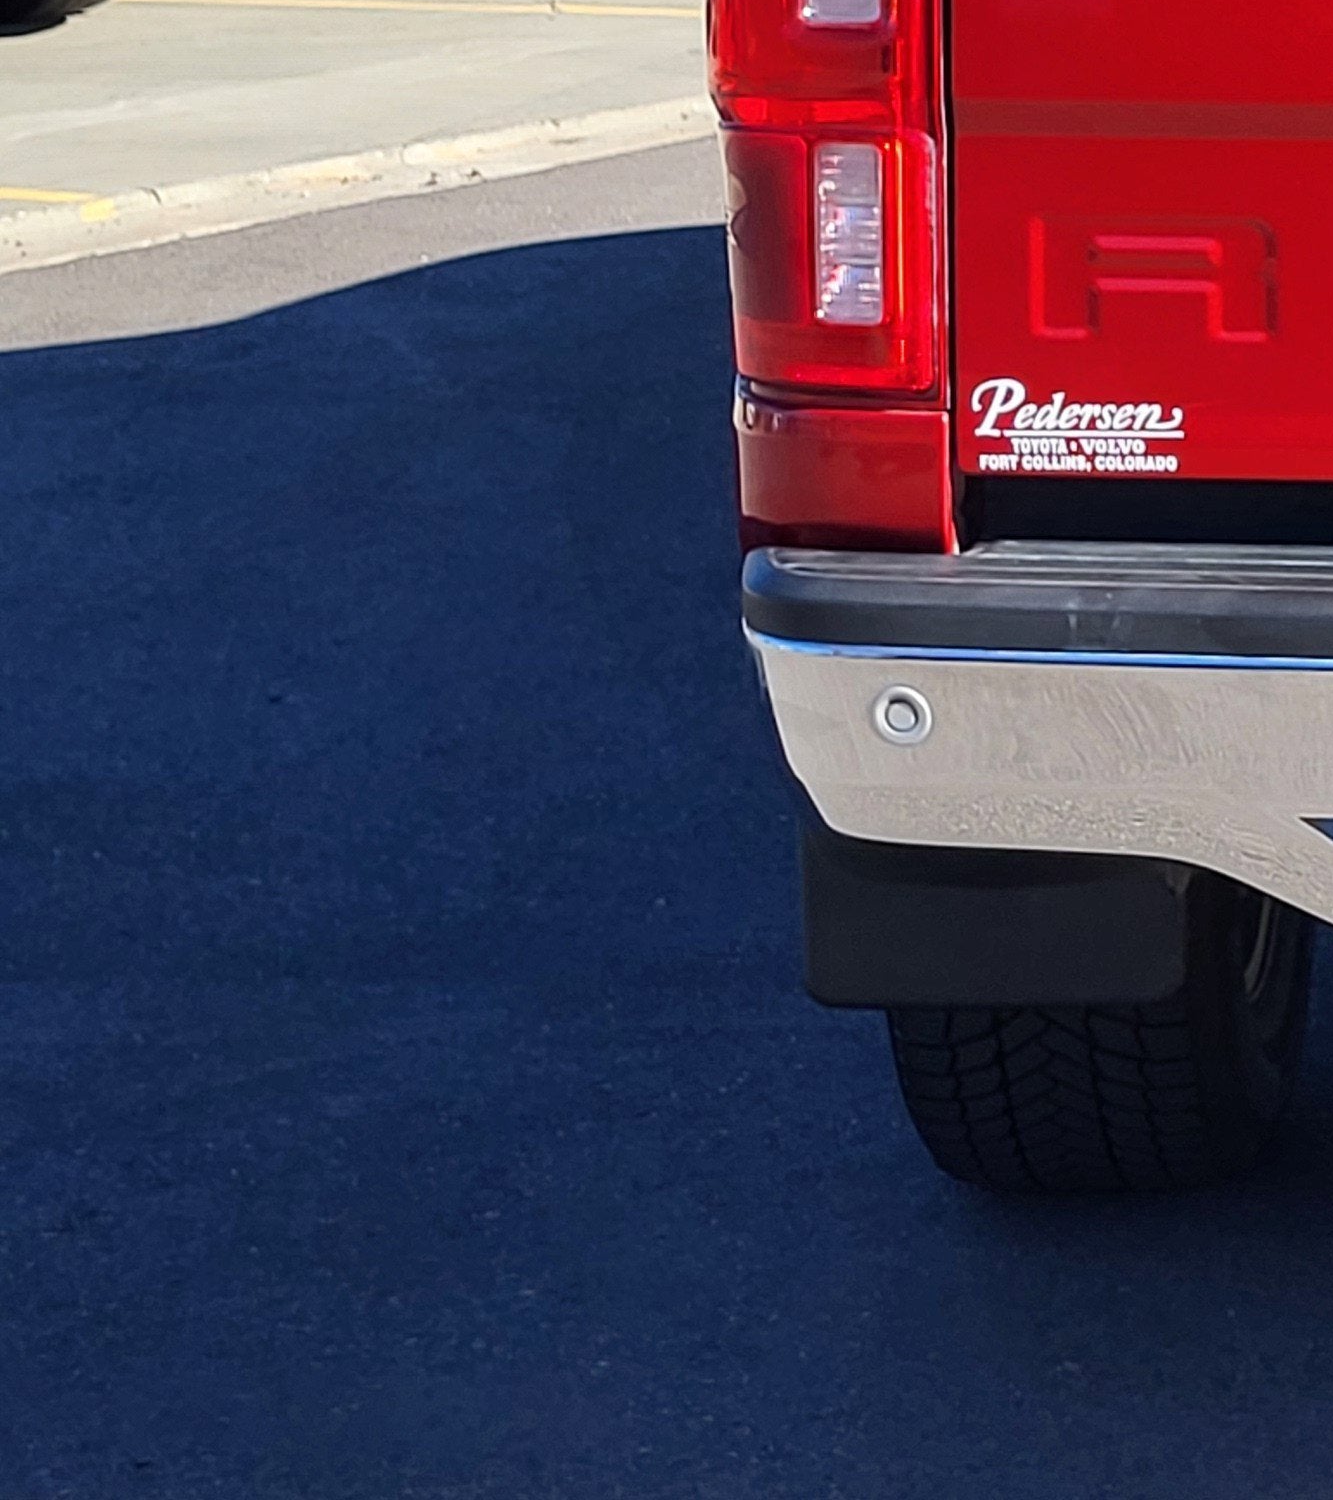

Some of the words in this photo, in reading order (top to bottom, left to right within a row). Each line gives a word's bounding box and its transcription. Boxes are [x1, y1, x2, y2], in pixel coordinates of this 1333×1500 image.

[971, 377, 1185, 438] Pedersen
[1010, 438, 1069, 455] TOYOTA
[1079, 439, 1146, 455] VOLVO
[978, 454, 1019, 471] FORT
